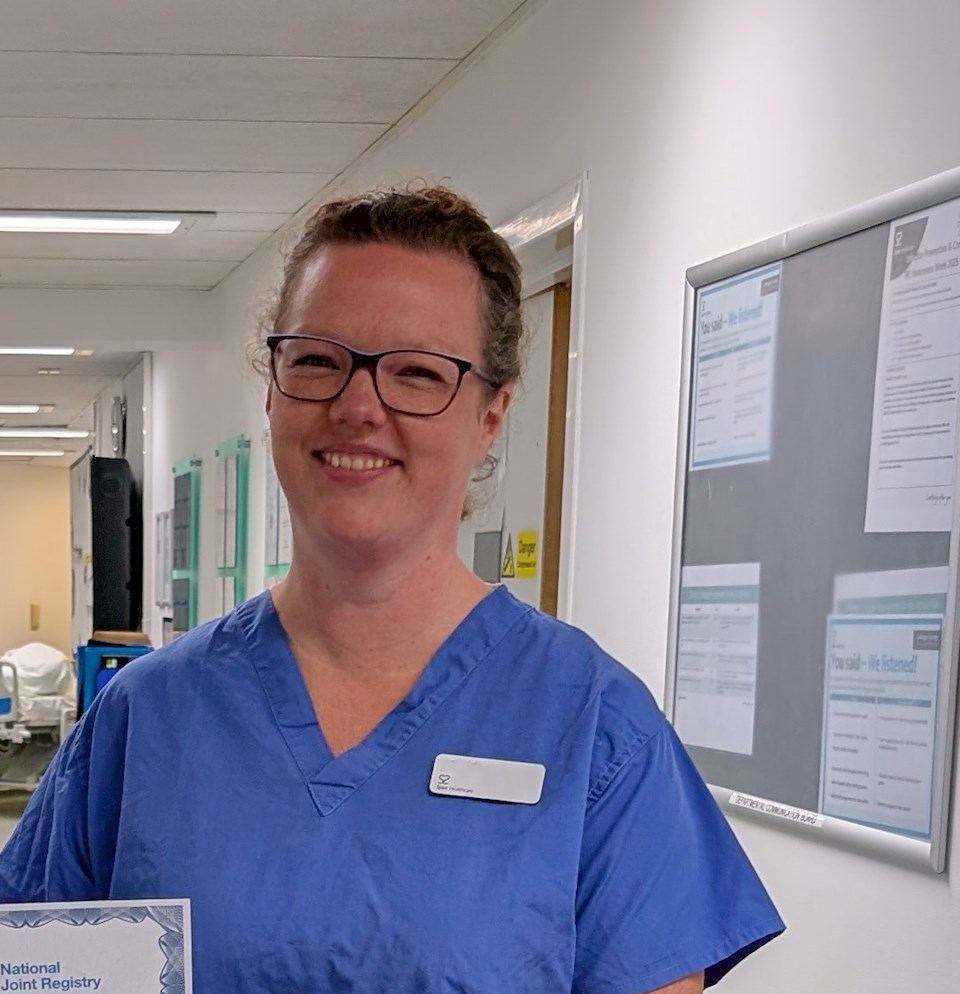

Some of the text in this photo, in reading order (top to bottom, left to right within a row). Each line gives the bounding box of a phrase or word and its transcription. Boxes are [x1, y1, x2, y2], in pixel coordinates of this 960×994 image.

[831, 653, 844, 670] You
[845, 653, 860, 671] said
[868, 654, 880, 672] We
[881, 653, 917, 673] listened!
[1, 961, 61, 976] National
[1, 977, 102, 992] Joint Registry
